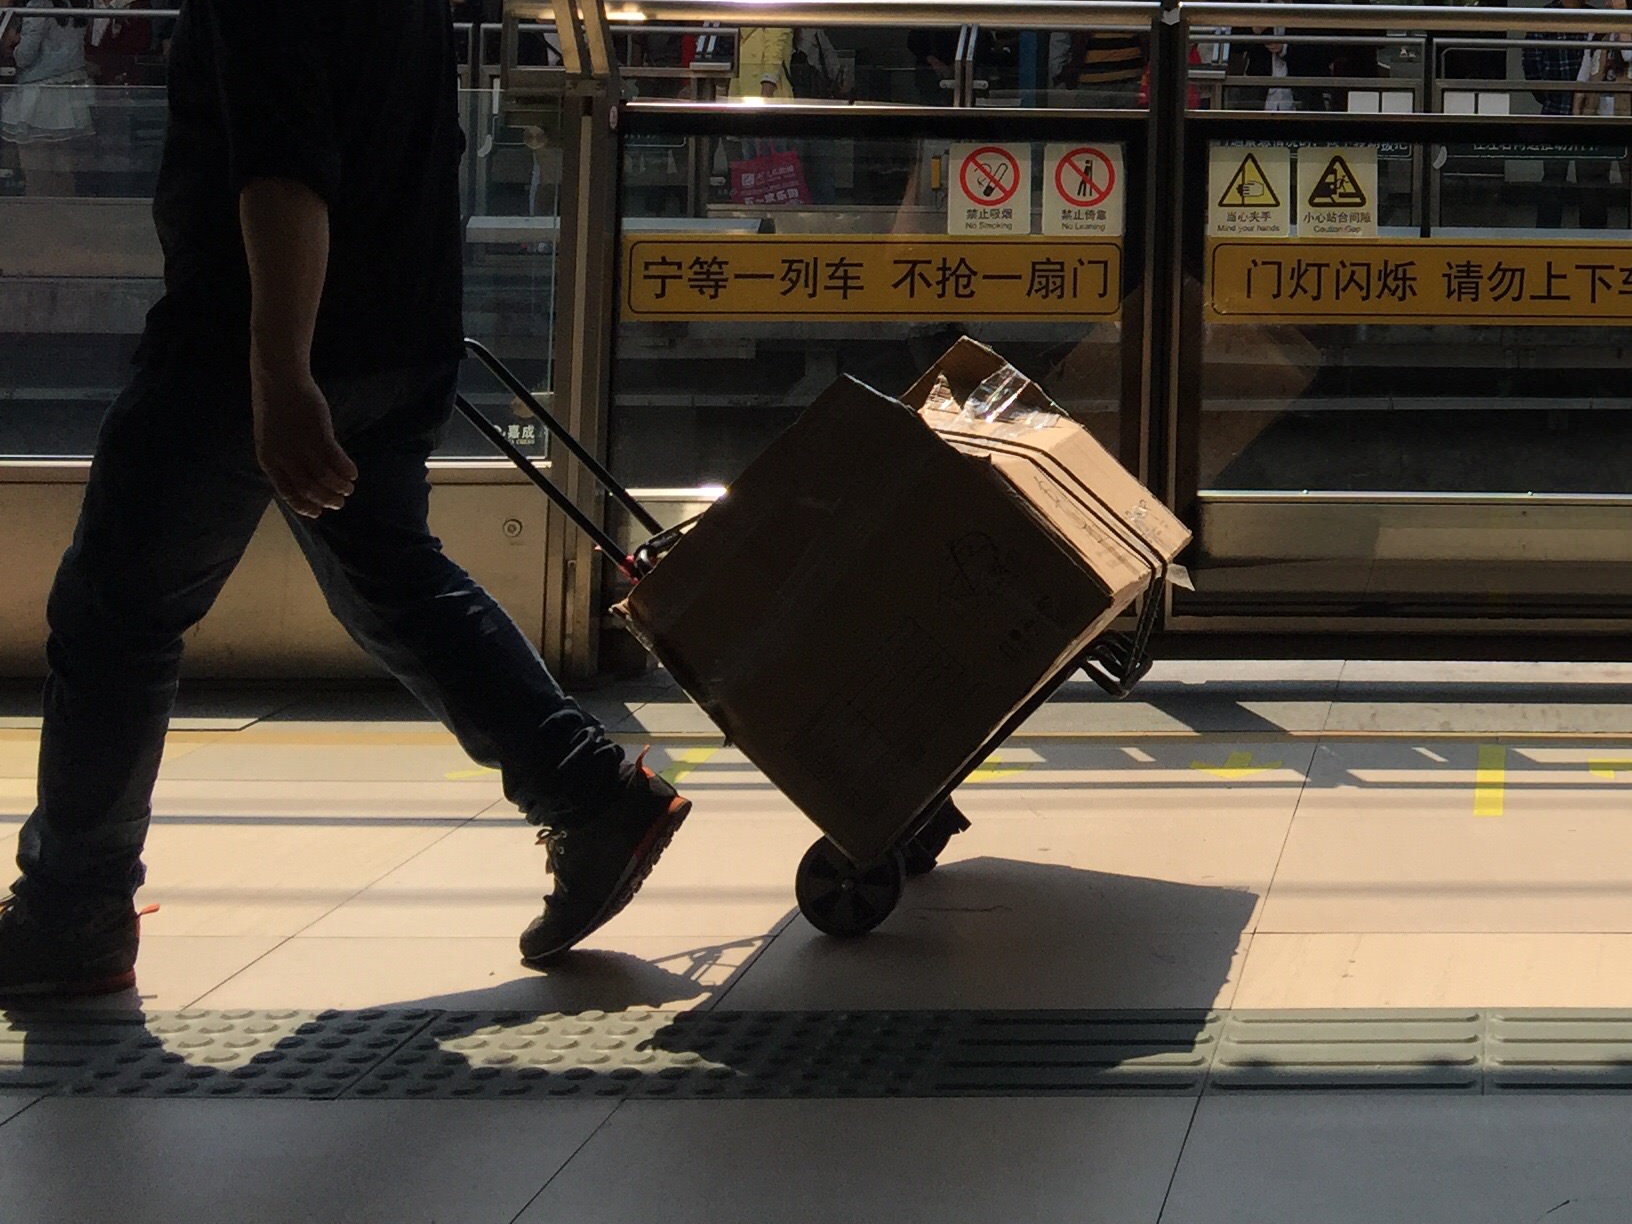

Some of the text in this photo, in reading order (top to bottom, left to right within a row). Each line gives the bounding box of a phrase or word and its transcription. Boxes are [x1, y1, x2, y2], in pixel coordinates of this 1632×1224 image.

[966, 208, 1013, 221] 禁止吸烟
[1061, 209, 1107, 222] 禁止倚靠
[1226, 211, 1272, 223] 当心夹手
[1303, 212, 1372, 225] 小心站台间隙
[965, 222, 1013, 231] No Smoking
[1061, 223, 1073, 231] No
[1217, 224, 1236, 233] Mind
[642, 255, 1110, 300] 宁等一列车 不抢一扇门
[1246, 258, 1418, 302] 门灯闪烁
